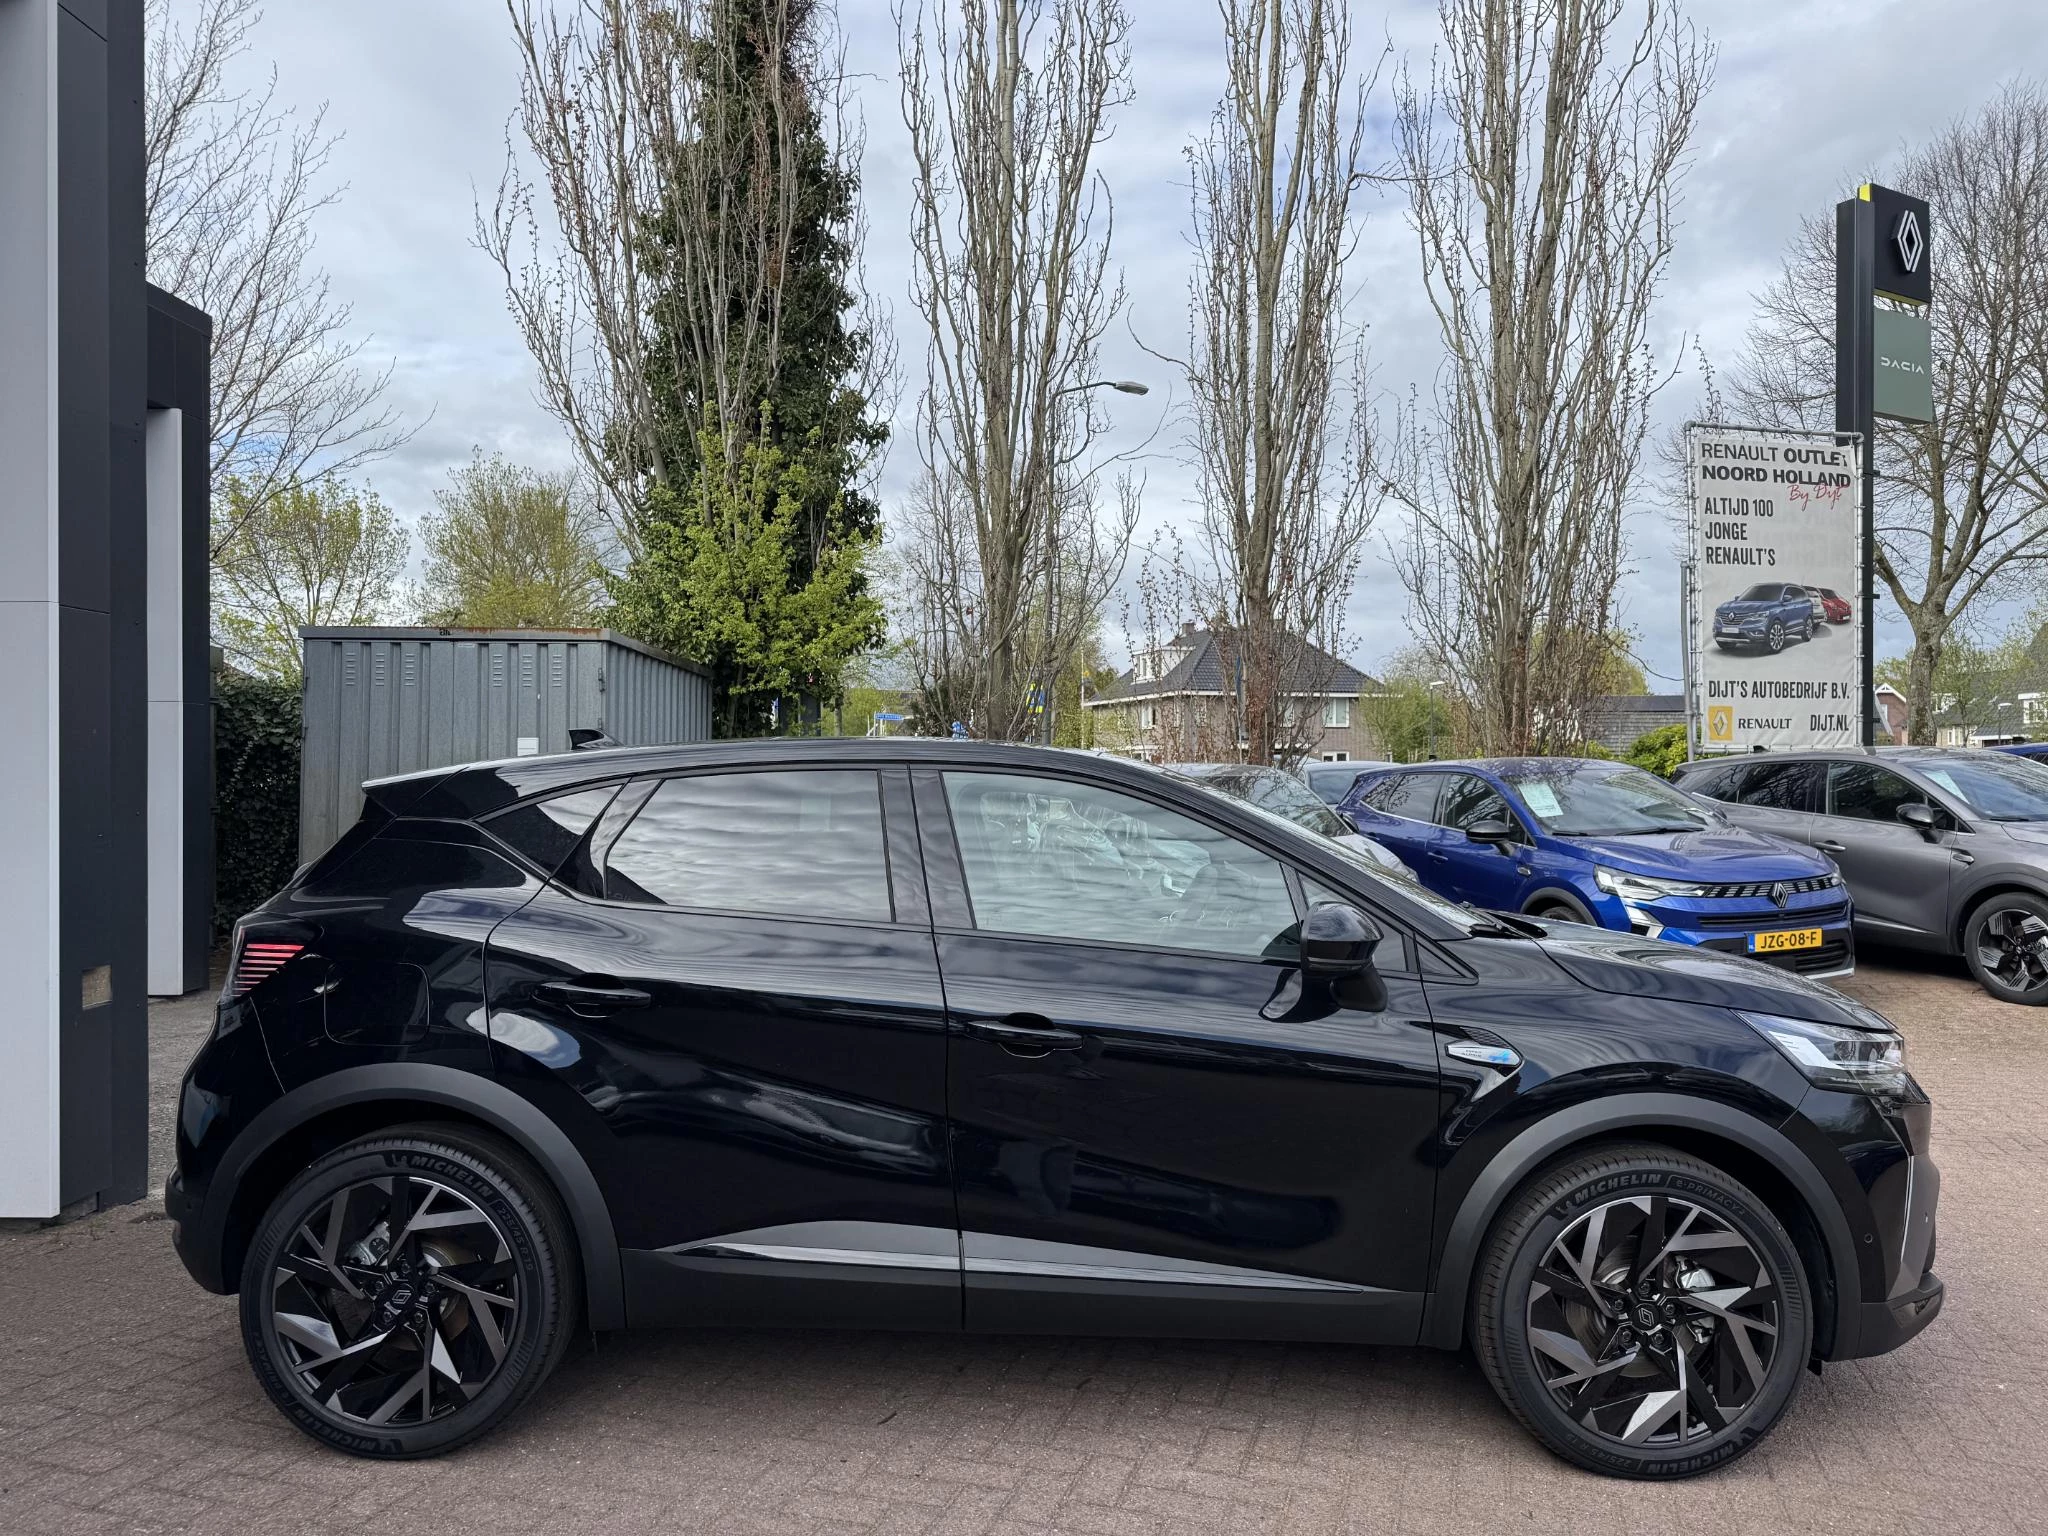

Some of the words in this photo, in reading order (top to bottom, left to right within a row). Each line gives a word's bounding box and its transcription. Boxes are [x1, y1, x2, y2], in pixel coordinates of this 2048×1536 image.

[1880, 356, 1925, 375] DACIA
[1701, 442, 1779, 462] RENAULT
[1702, 464, 1768, 482] NOORD
[1773, 468, 1851, 488] HOLLAND
[1704, 496, 1749, 516] ALTIJD
[1752, 499, 1774, 518] 100
[1787, 484, 1811, 511] By
[1704, 521, 1748, 541] JONGE
[1705, 546, 1776, 566] RENAULT'S
[1708, 680, 1748, 699] DIJT'S
[1751, 680, 1828, 699] AUTOBEDRIJF
[1831, 682, 1850, 700] B.V.
[1738, 717, 1792, 730] RENAULT
[1809, 714, 1849, 732] DIJT.NL
[1760, 931, 1817, 949] JZG-08-F
[410, 1154, 494, 1198] MICHELIN
[1574, 1173, 1662, 1205] MICHELIN
[1646, 1443, 1734, 1475] MICHELIN
